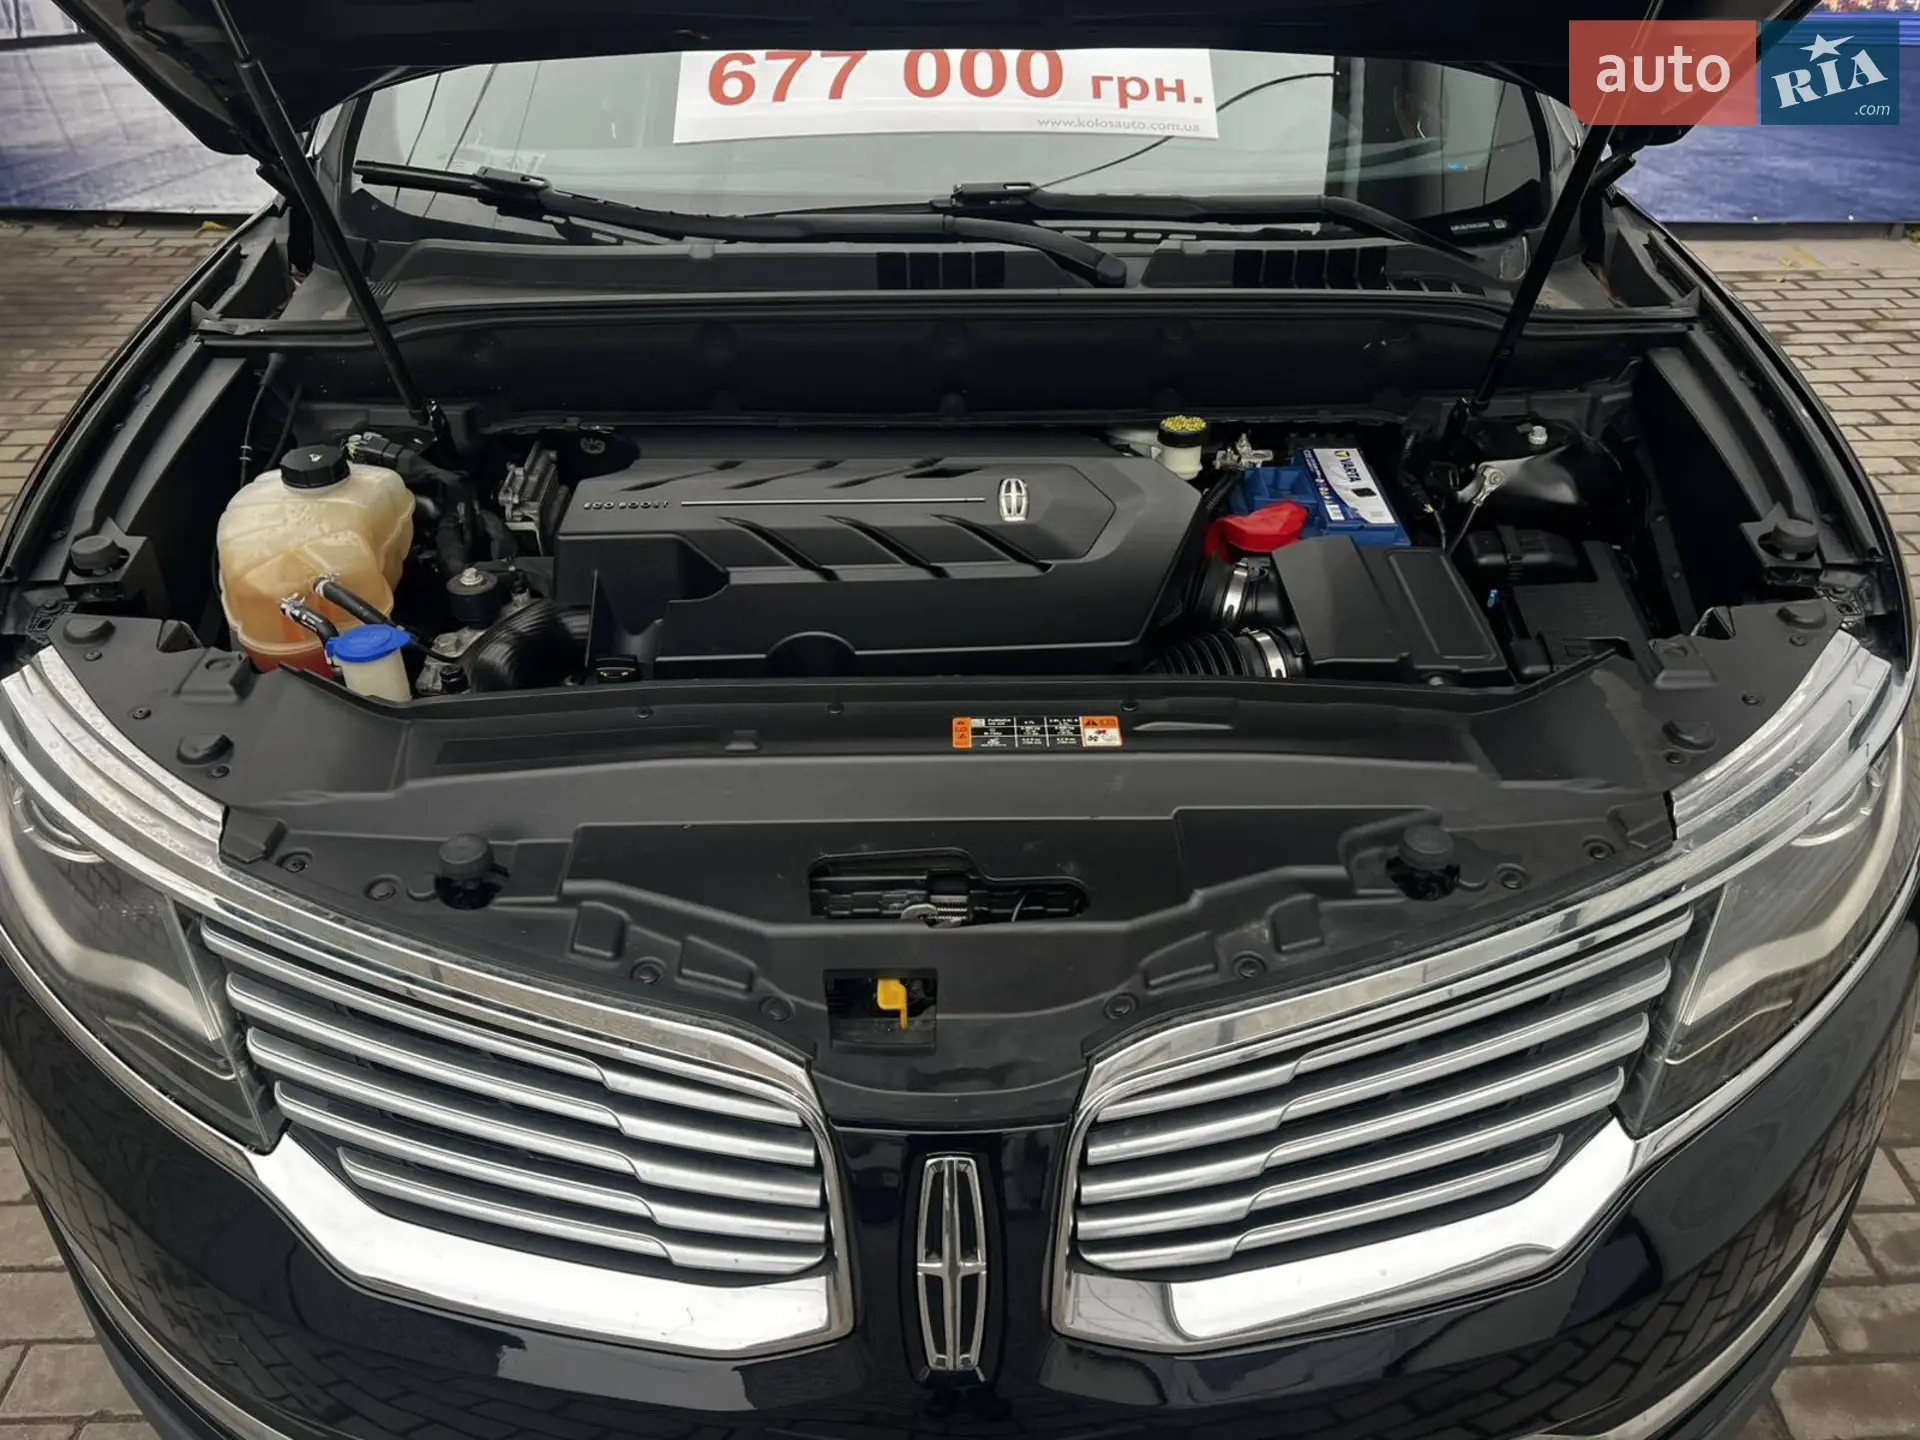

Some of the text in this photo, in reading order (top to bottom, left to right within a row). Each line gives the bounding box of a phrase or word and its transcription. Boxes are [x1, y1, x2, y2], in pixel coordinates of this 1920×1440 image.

[708, 49, 1202, 109] 677 000 грн.
[1037, 117, 1201, 133] www.kolosauto.com.ua
[1340, 458, 1361, 482] VARTA
